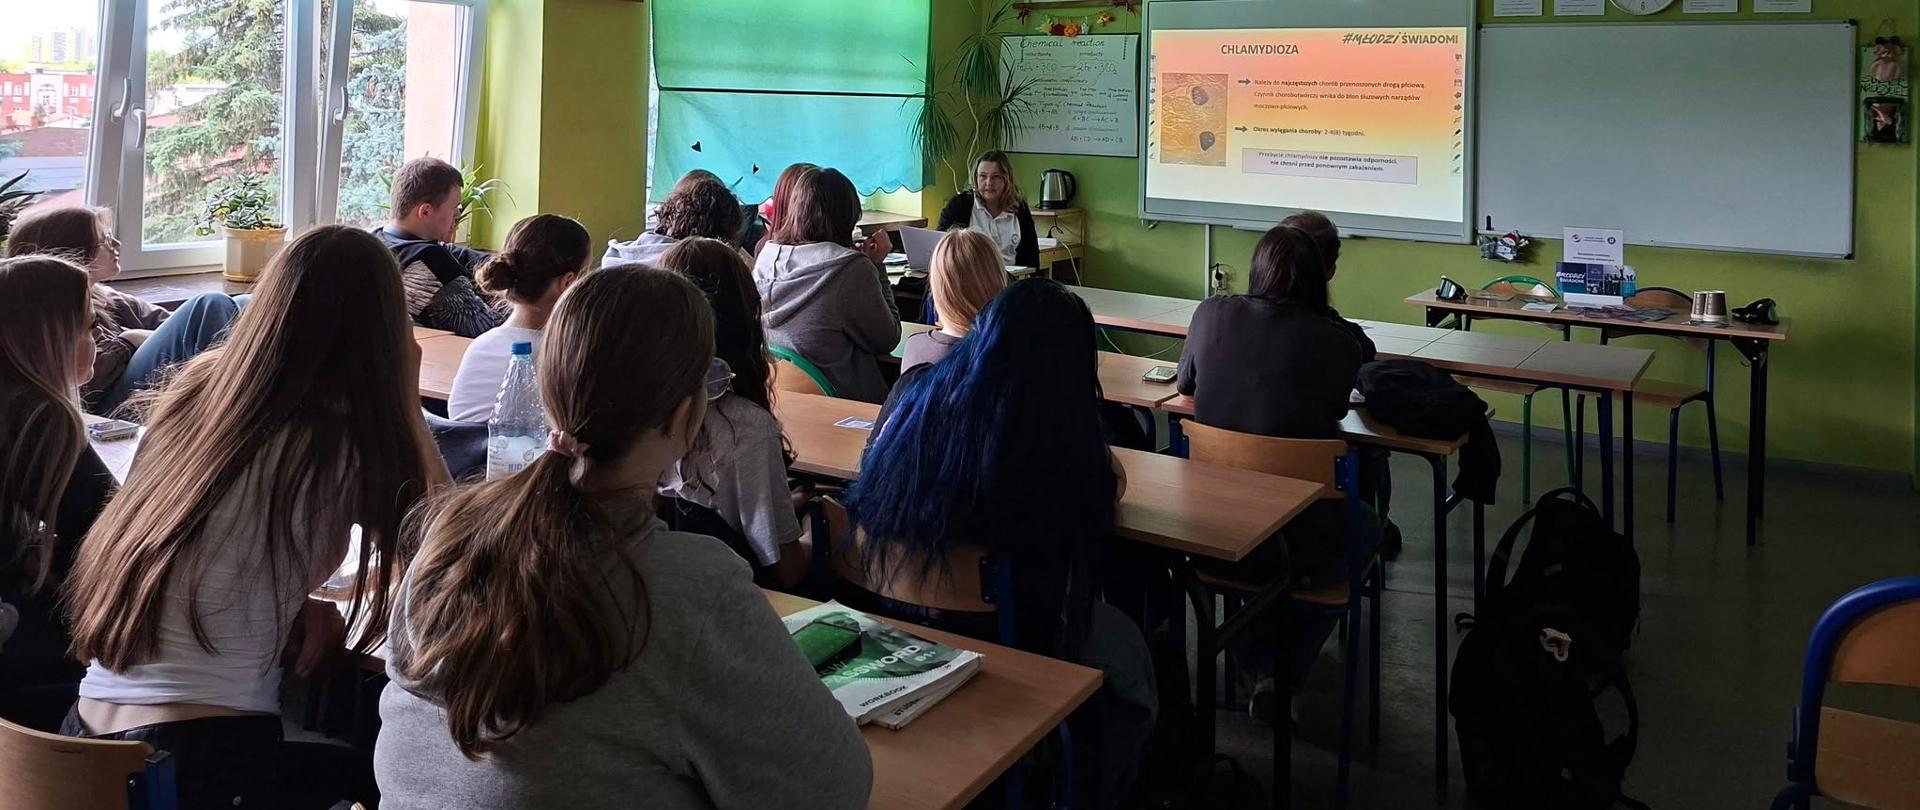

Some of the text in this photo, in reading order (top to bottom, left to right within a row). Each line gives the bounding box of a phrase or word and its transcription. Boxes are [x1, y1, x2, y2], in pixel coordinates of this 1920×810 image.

[1020, 37, 1063, 49] Chemical
[1401, 31, 1459, 45] ŚWIADOMI
[1220, 44, 1299, 55] CHLAMYDIOZA
[1382, 81, 1400, 89] drogą
[859, 684, 908, 708] WORKBOOK
